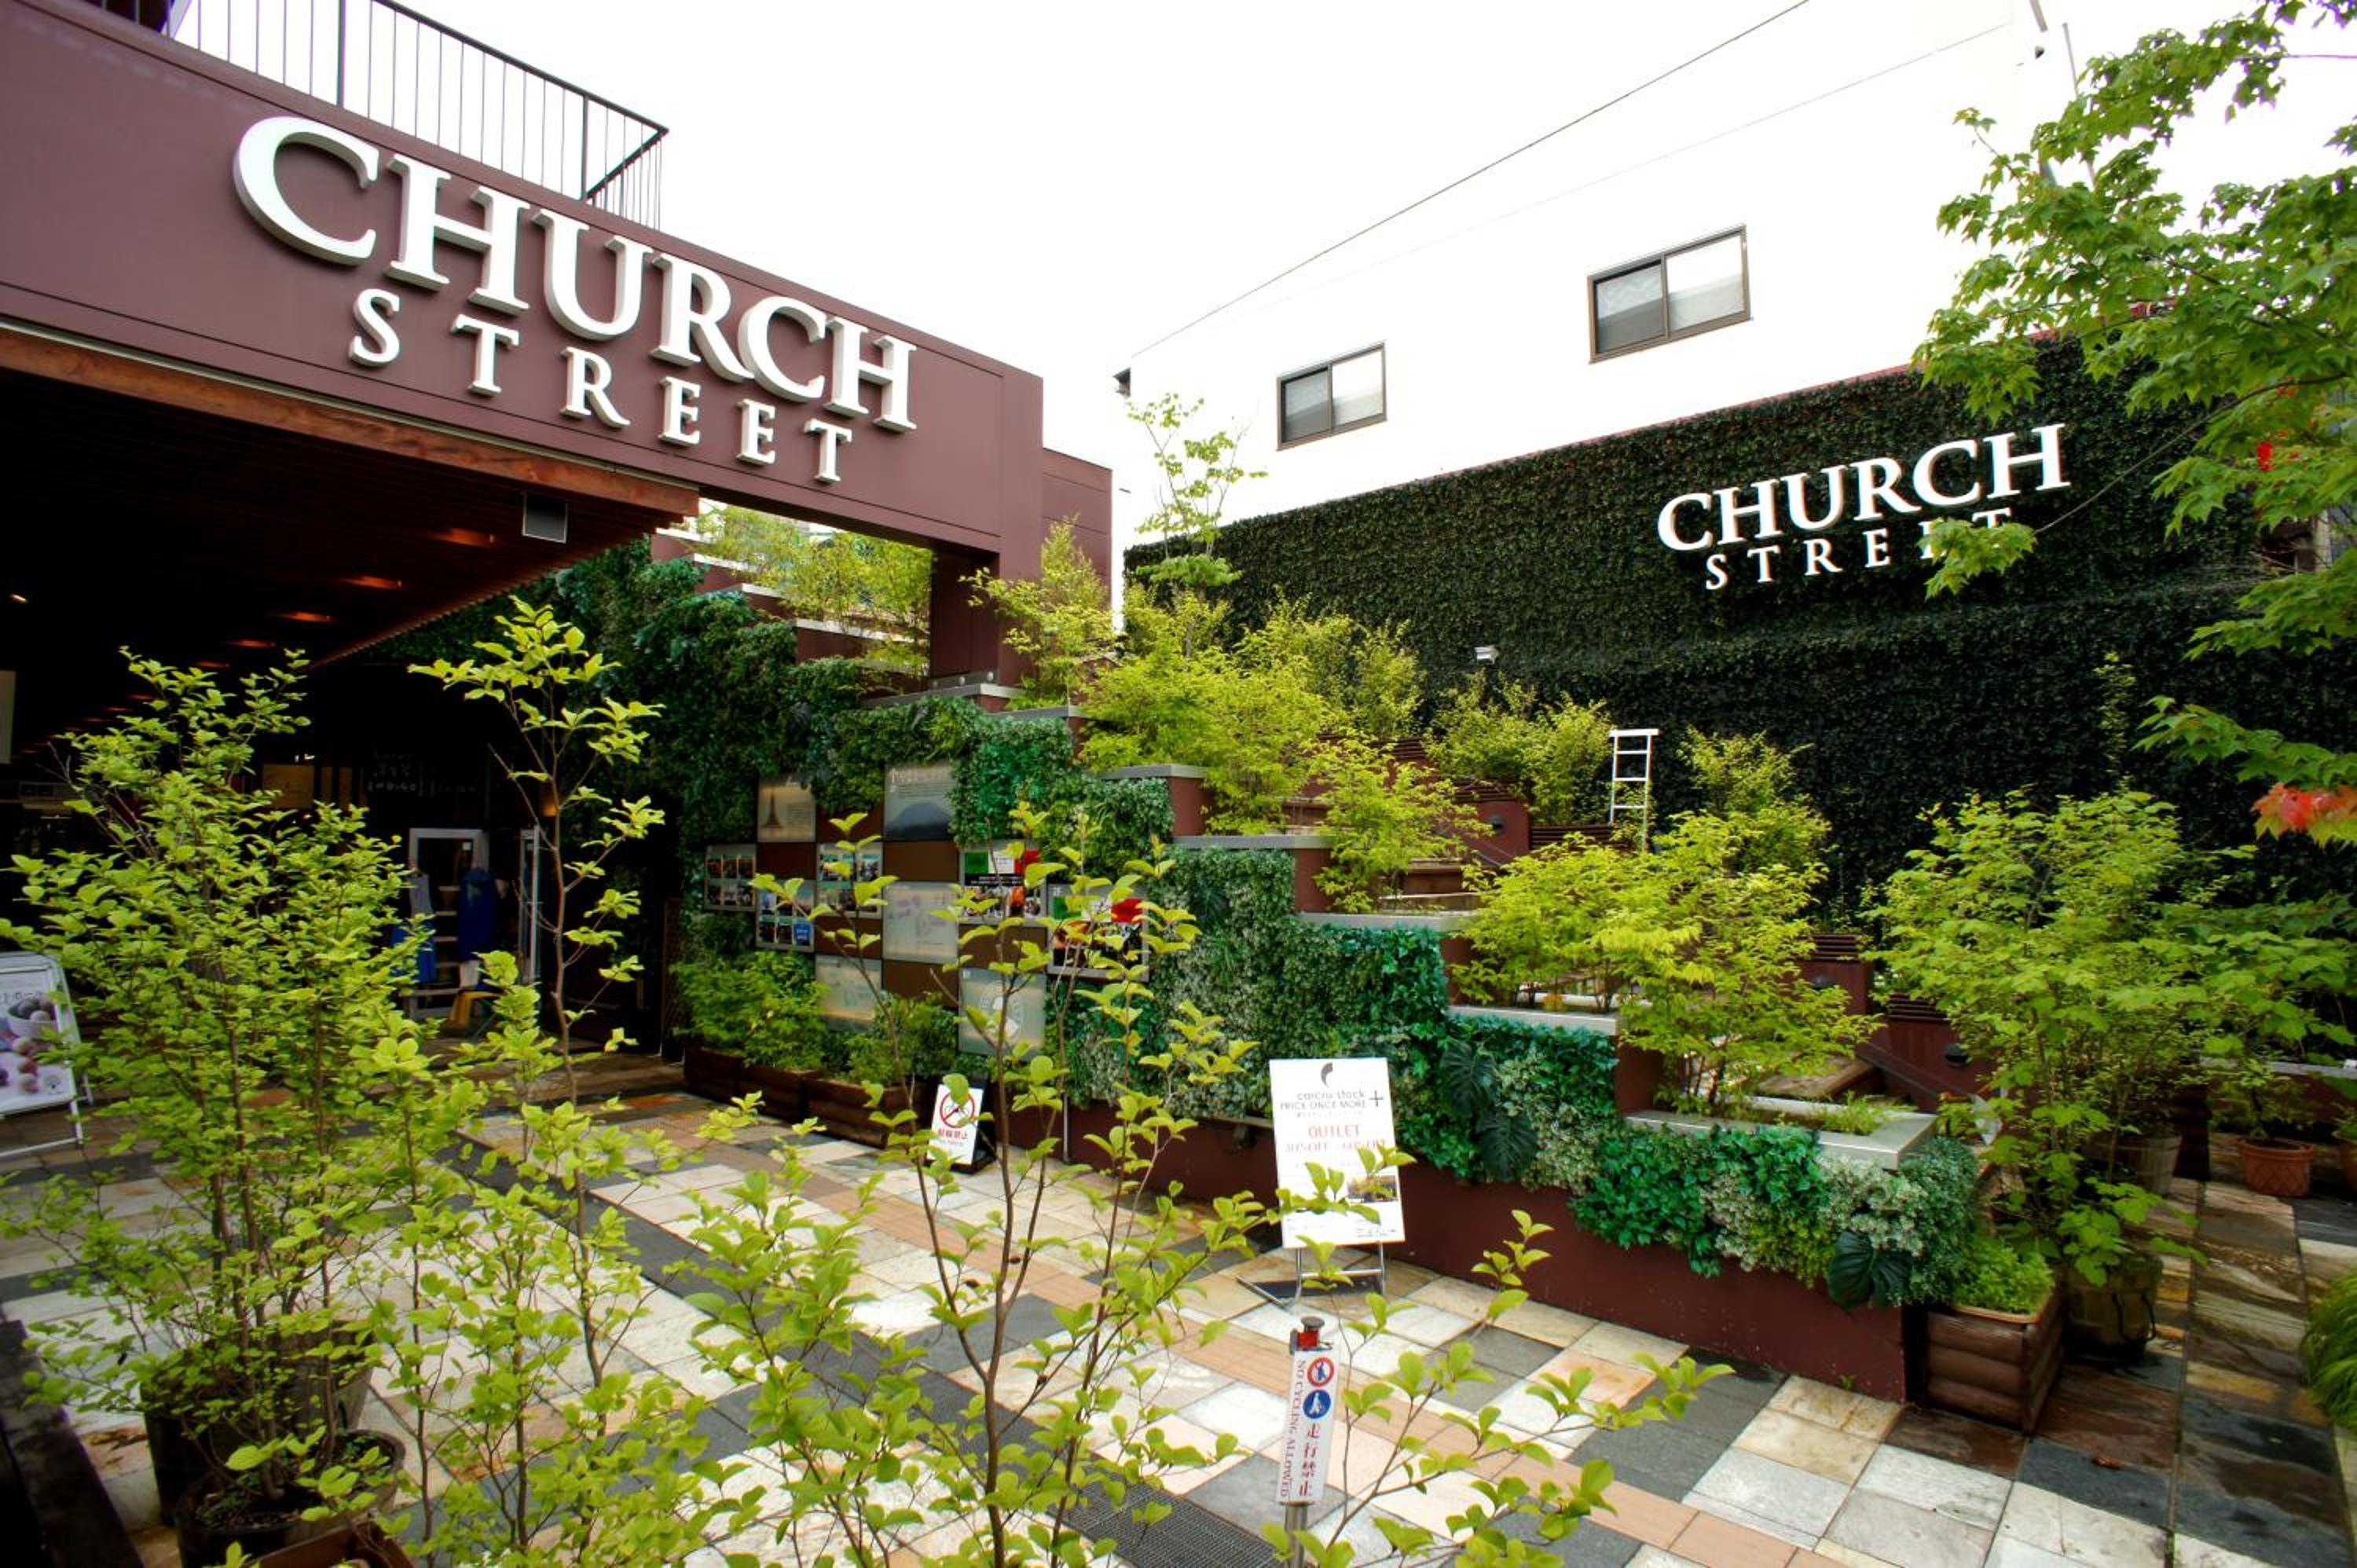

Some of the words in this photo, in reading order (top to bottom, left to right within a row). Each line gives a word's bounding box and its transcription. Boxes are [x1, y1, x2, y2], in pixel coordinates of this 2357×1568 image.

[233, 115, 917, 433] CHURCH
[348, 288, 852, 483] STREET
[1657, 423, 2071, 551] CHURCH
[1308, 1123, 1360, 1138] OUTLET
[1288, 1381, 1304, 1434] CYCLING
[1281, 1438, 1296, 1497] ALLOWED
[1299, 1423, 1321, 1497] 走行禁止
